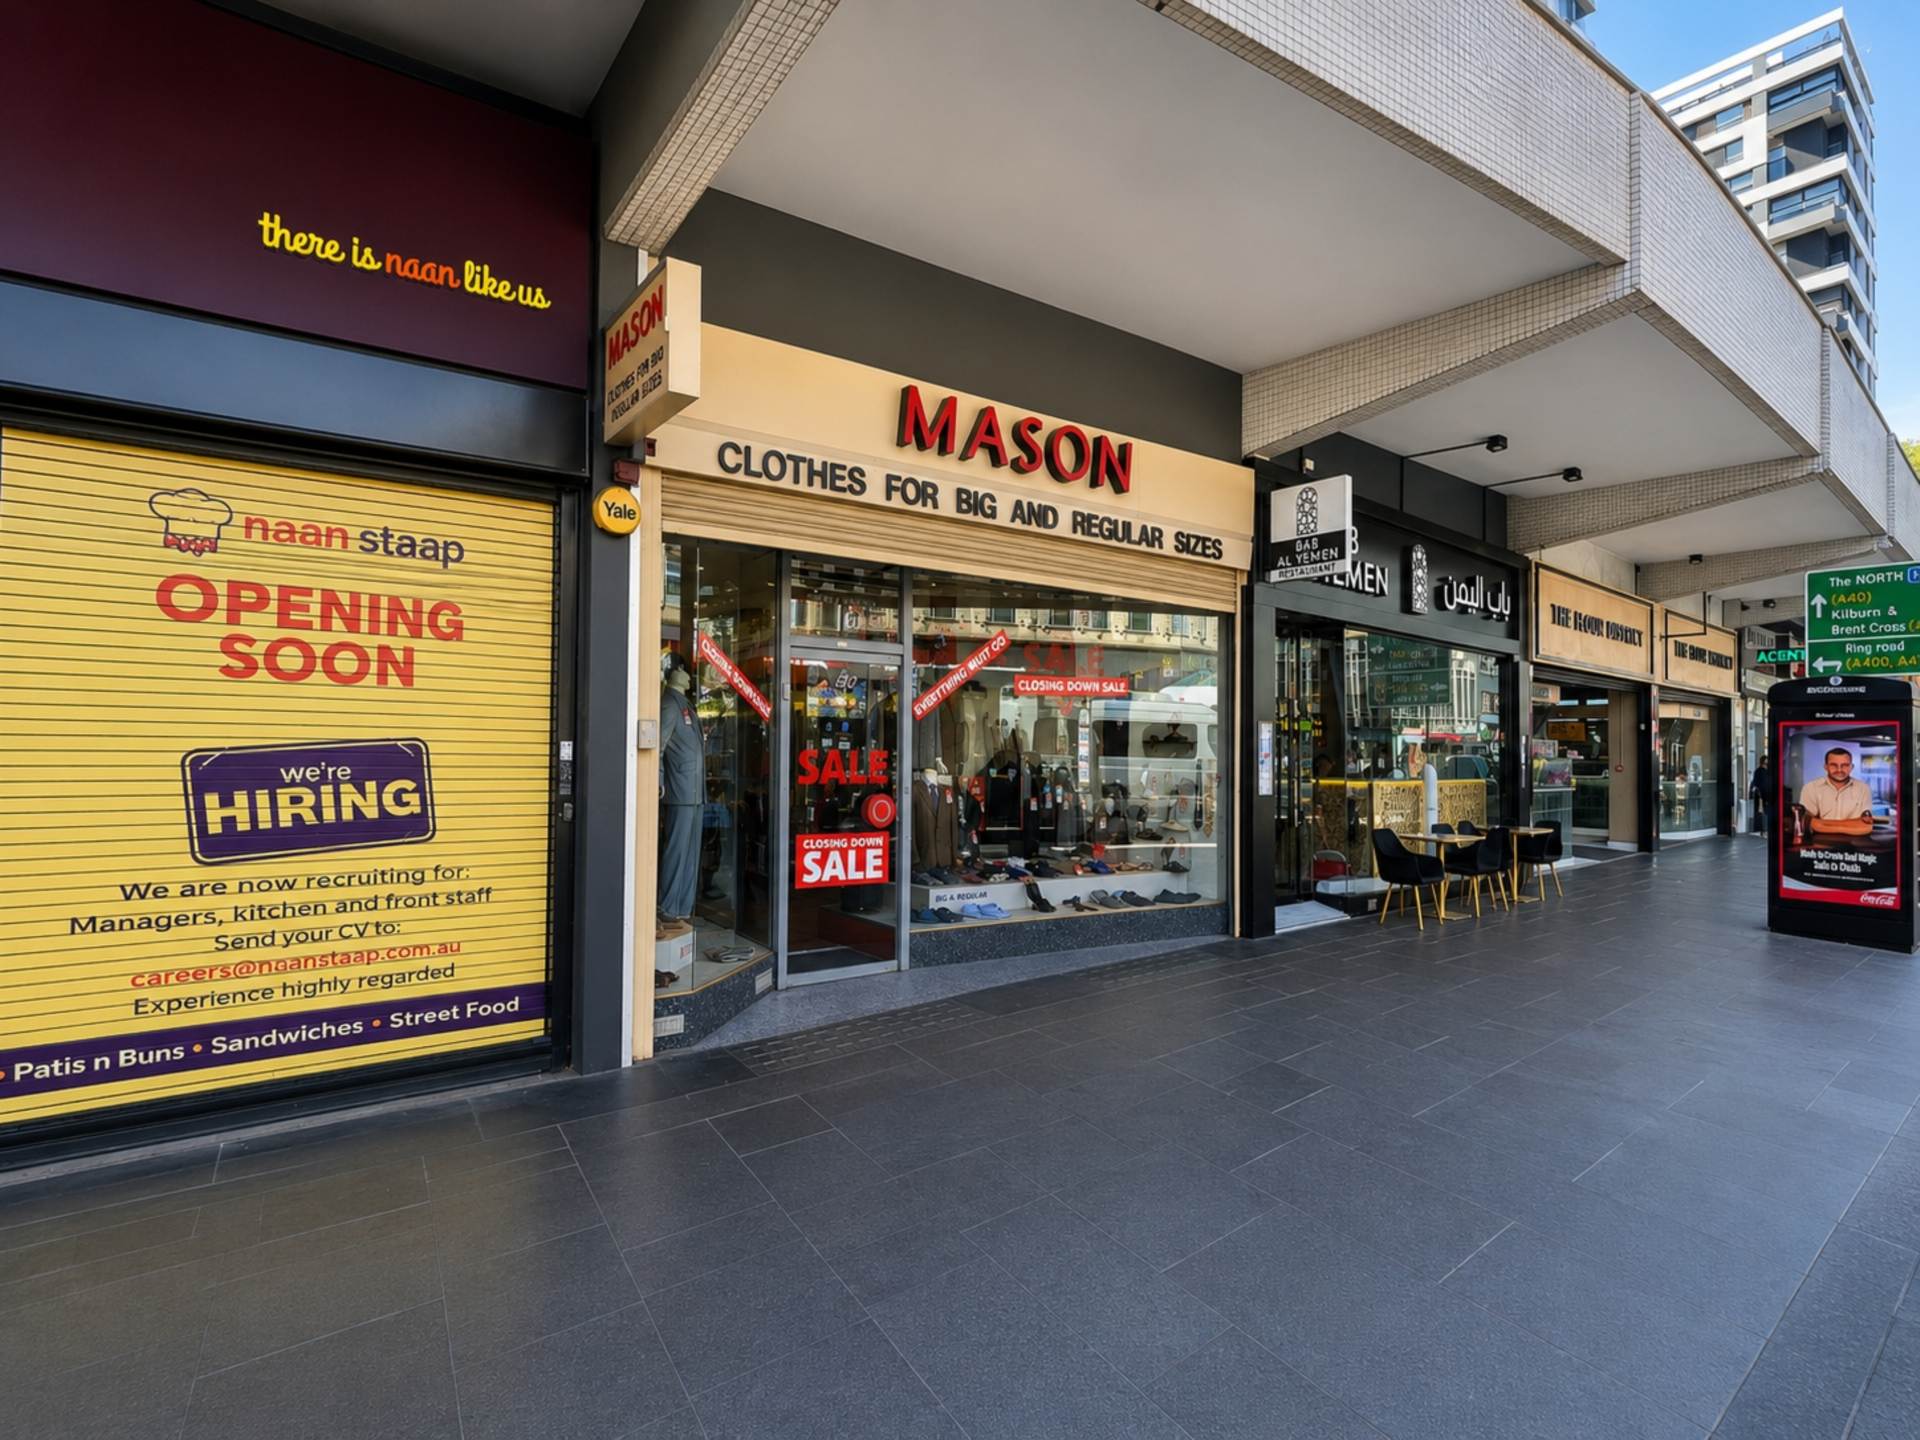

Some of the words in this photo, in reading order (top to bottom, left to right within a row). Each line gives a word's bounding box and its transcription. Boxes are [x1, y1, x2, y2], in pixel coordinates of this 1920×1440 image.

[258, 211, 346, 264] there
[351, 236, 383, 273] is
[385, 247, 461, 290] naan
[463, 260, 517, 303] like
[517, 284, 551, 310] us
[607, 284, 665, 371] MASON
[896, 384, 1133, 494] MASON
[604, 500, 637, 520] Yale
[717, 441, 867, 496] CLOTHES
[885, 474, 939, 510] FOR
[956, 487, 998, 520] BIG
[1010, 499, 1059, 530] AND
[1072, 510, 1164, 550] REGULAR
[1174, 531, 1223, 560] SIZES
[244, 514, 349, 550] naan
[358, 524, 465, 569] staap
[1277, 556, 1292, 567] AL
[1295, 547, 1338, 564] YEMEN
[1295, 537, 1318, 552] BAB
[1443, 575, 1485, 614] اليمن
[1829, 577, 1851, 588] The
[1856, 571, 1904, 585] NORTH
[156, 573, 464, 641] OPENING
[1487, 581, 1511, 622] باب
[1550, 604, 1571, 628] THE
[1831, 591, 1872, 606] (A40)
[1831, 608, 1881, 620] Kilburn
[1888, 606, 1897, 616] &
[1831, 623, 1866, 635] Brent
[1869, 620, 1906, 633] Cross
[218, 633, 415, 688] SOON
[1845, 643, 1872, 655] Ring
[1876, 640, 1905, 652] road
[1018, 680, 1064, 692] CLOSING
[1067, 681, 1099, 692] DOWN
[1102, 682, 1126, 692] SALE
[280, 762, 352, 782] we're
[797, 749, 889, 785] SALE
[205, 779, 421, 836] HIRING
[803, 837, 848, 849] CLOSING
[851, 836, 883, 848] DOWN
[120, 882, 170, 902] We
[180, 880, 227, 898] are
[238, 875, 297, 894] now
[306, 867, 426, 890] recruiting
[433, 864, 470, 883] for:
[802, 848, 883, 883] SALE
[69, 908, 225, 937] Managers,
[233, 897, 327, 923] kitchen
[335, 893, 379, 913] and
[385, 889, 439, 909] front
[445, 886, 493, 905] staff
[214, 929, 276, 951] Send
[282, 926, 333, 947] your
[338, 921, 368, 940] CV
[373, 919, 401, 936] to:
[130, 941, 461, 988] careers@naanstaap.com.au
[134, 983, 274, 1017] Experience
[282, 974, 351, 1000] highly
[358, 963, 456, 989] regarded
[13, 1056, 86, 1082] Patis
[94, 1054, 110, 1072] n
[119, 1042, 184, 1068] Buns
[211, 1018, 364, 1055] Sandwiches
[390, 1003, 460, 1030] Street
[466, 997, 519, 1018] Food
